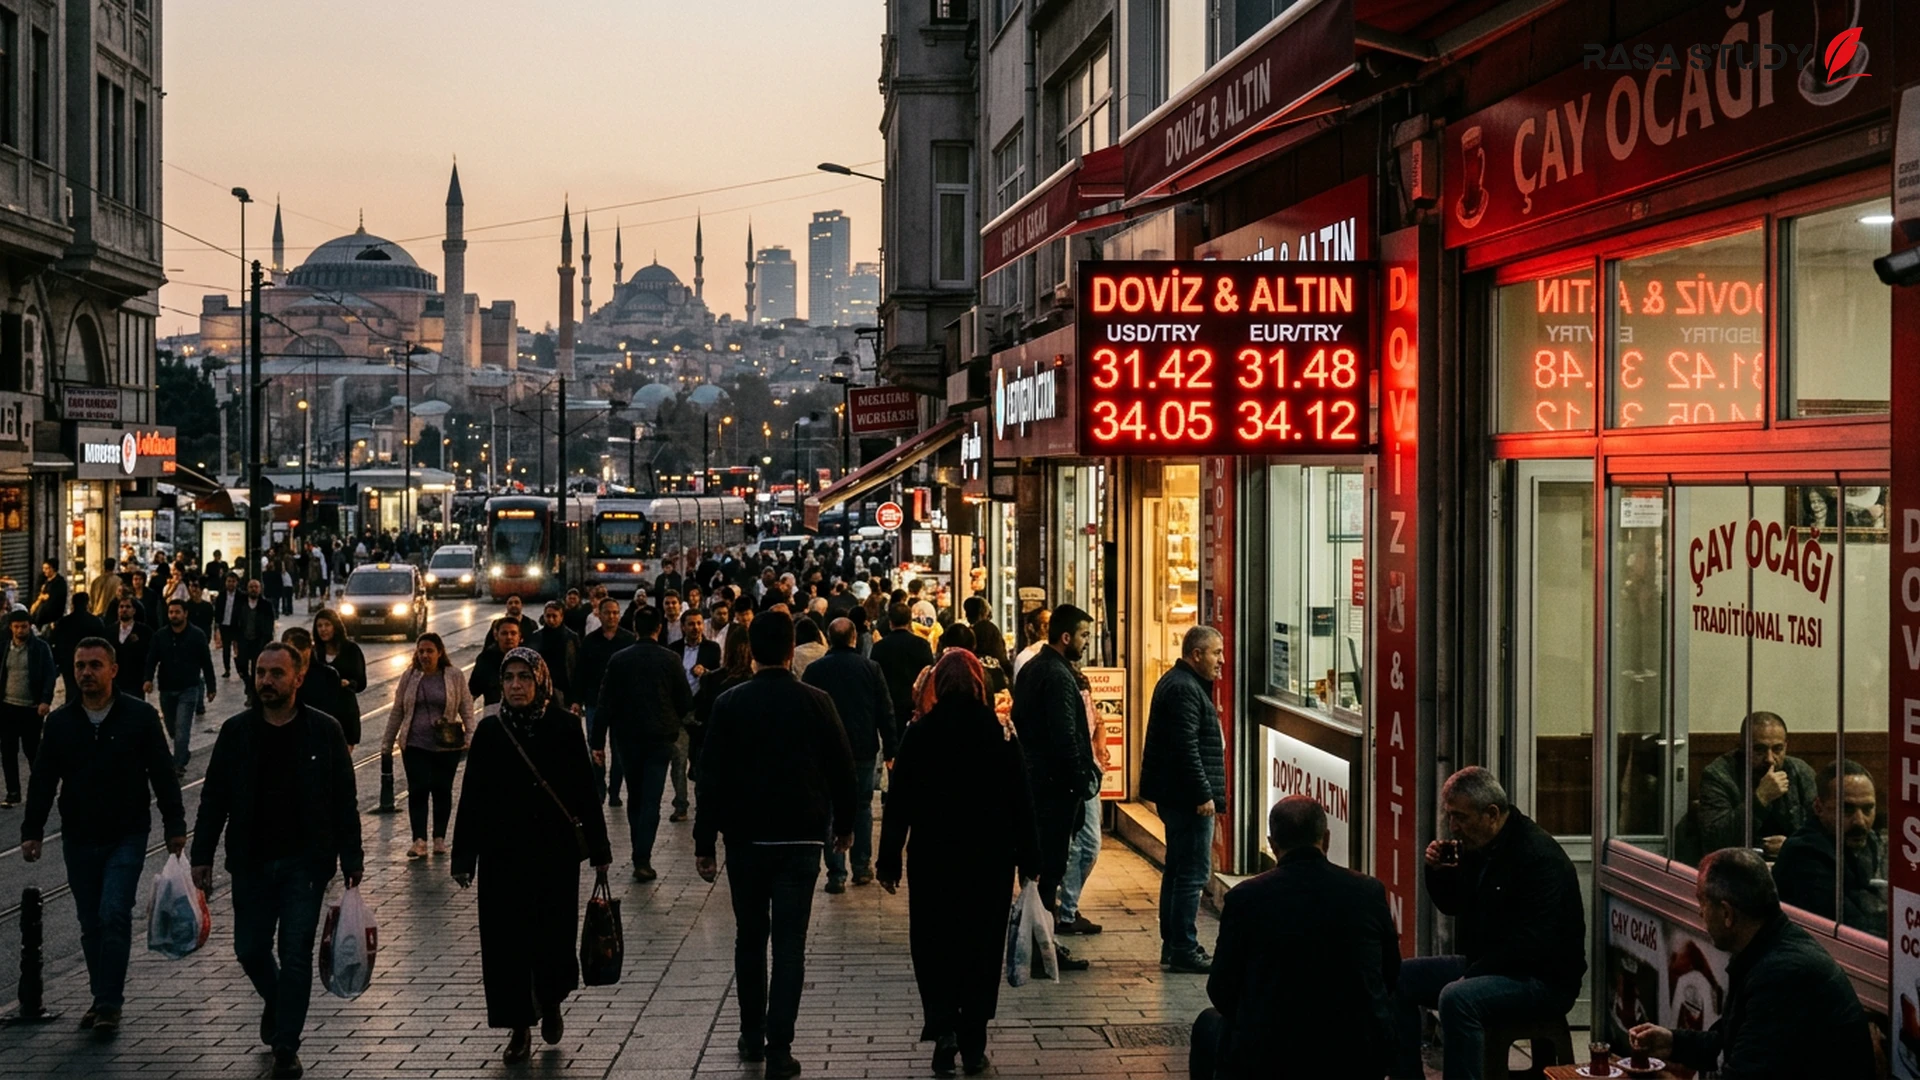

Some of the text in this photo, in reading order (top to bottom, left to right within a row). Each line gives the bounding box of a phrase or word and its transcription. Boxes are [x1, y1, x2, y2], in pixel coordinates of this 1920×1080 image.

[1165, 59, 1272, 167] DOVİZ & ALTIN
[1513, 93, 1592, 214] ÇAY
[1093, 269, 1353, 313] DOVİZ & ALTIN
[1107, 324, 1343, 342] USD/TRY EUR/TRY
[1092, 348, 1357, 389] 31.42 31.48
[1092, 400, 1357, 441] 34.05 34.12
[1689, 519, 1834, 604] ÇAY OCAĞI
[1788, 615, 1823, 649] TASI
[1316, 777, 1348, 823] ALTIN
